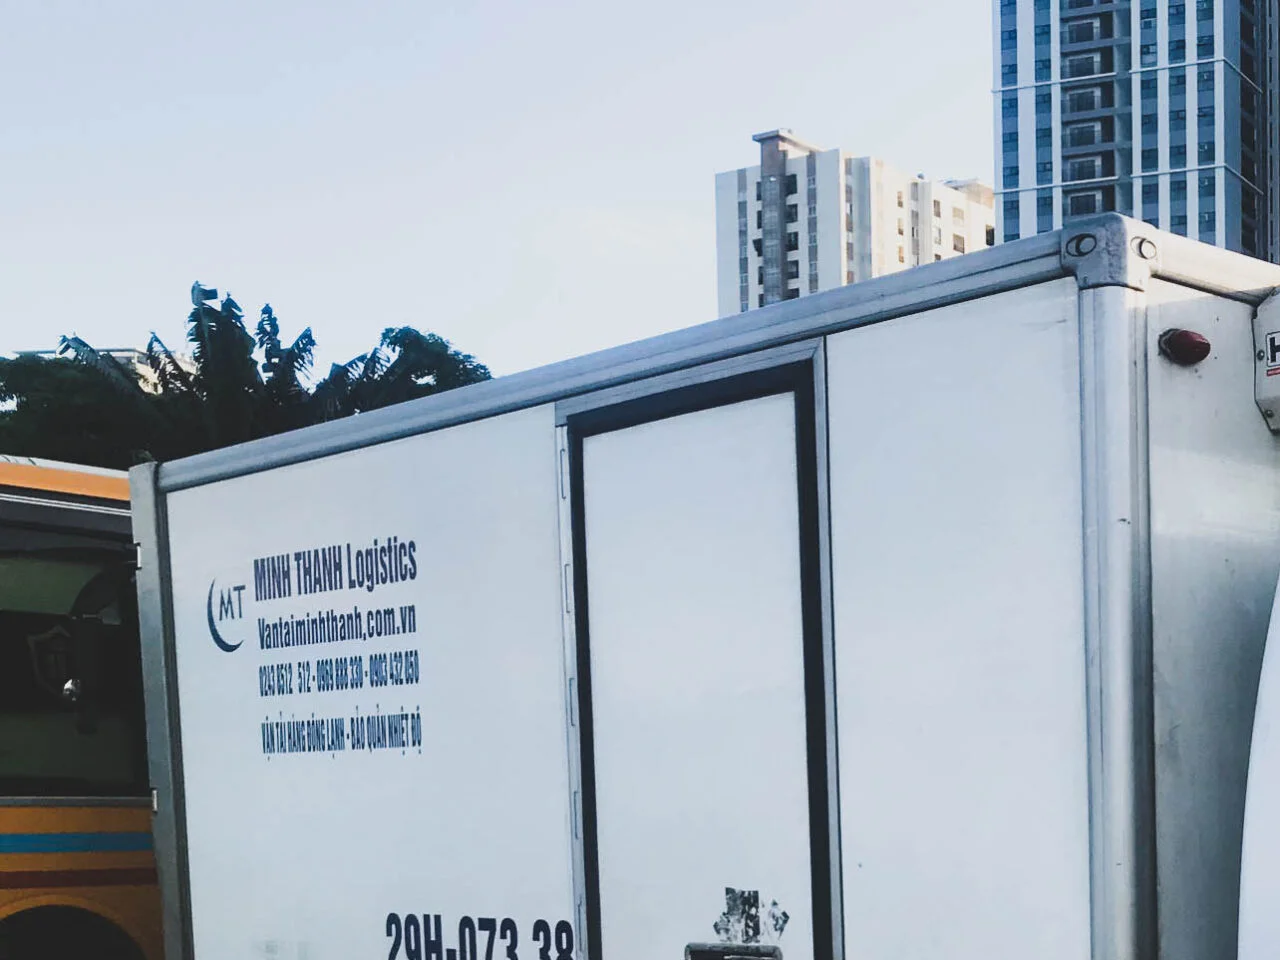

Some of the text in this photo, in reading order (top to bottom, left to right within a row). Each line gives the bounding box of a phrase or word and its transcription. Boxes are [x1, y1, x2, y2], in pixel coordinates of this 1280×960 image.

[254, 536, 417, 601] MINH THANH Logistics
